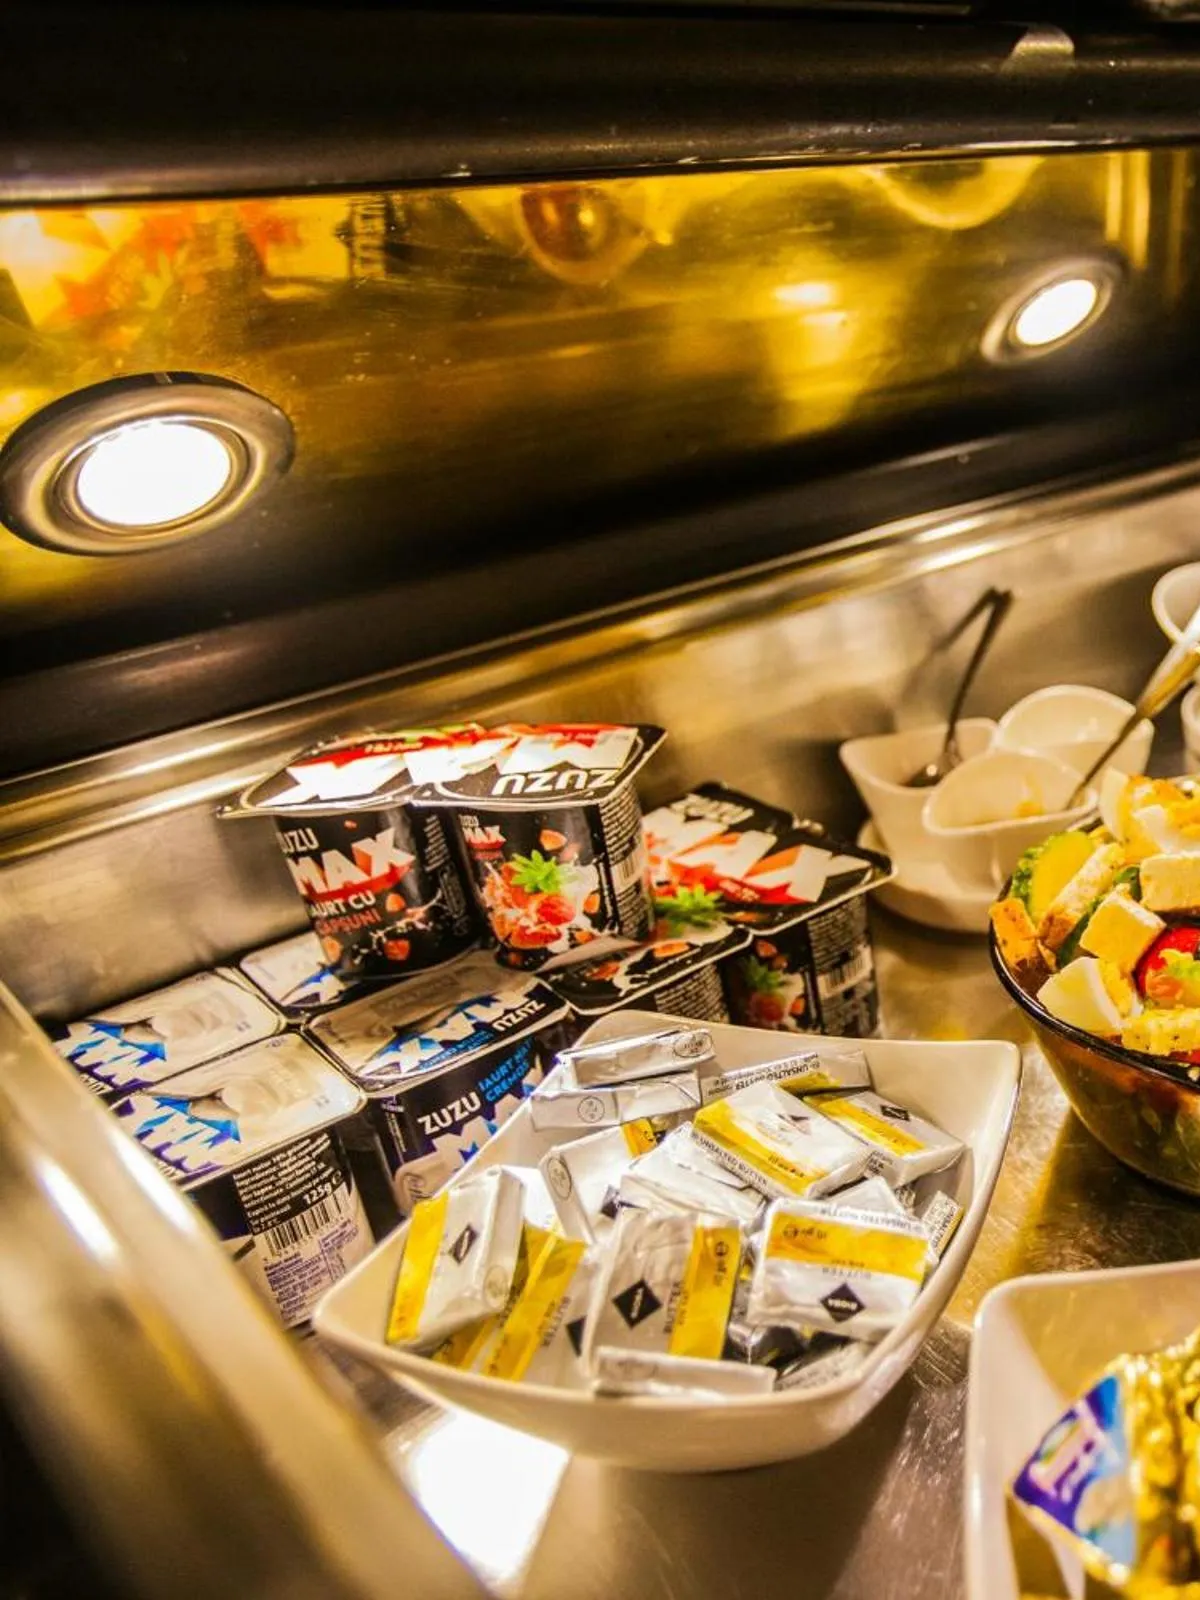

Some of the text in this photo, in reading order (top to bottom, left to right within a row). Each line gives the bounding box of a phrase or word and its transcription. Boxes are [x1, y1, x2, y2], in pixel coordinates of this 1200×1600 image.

[490, 768, 621, 796] ZUZU
[277, 827, 320, 854] UZU
[286, 827, 416, 897] MAX
[309, 889, 377, 919] AURT CU
[492, 999, 547, 1032] ZUZU
[417, 1091, 482, 1135] ZUZU
